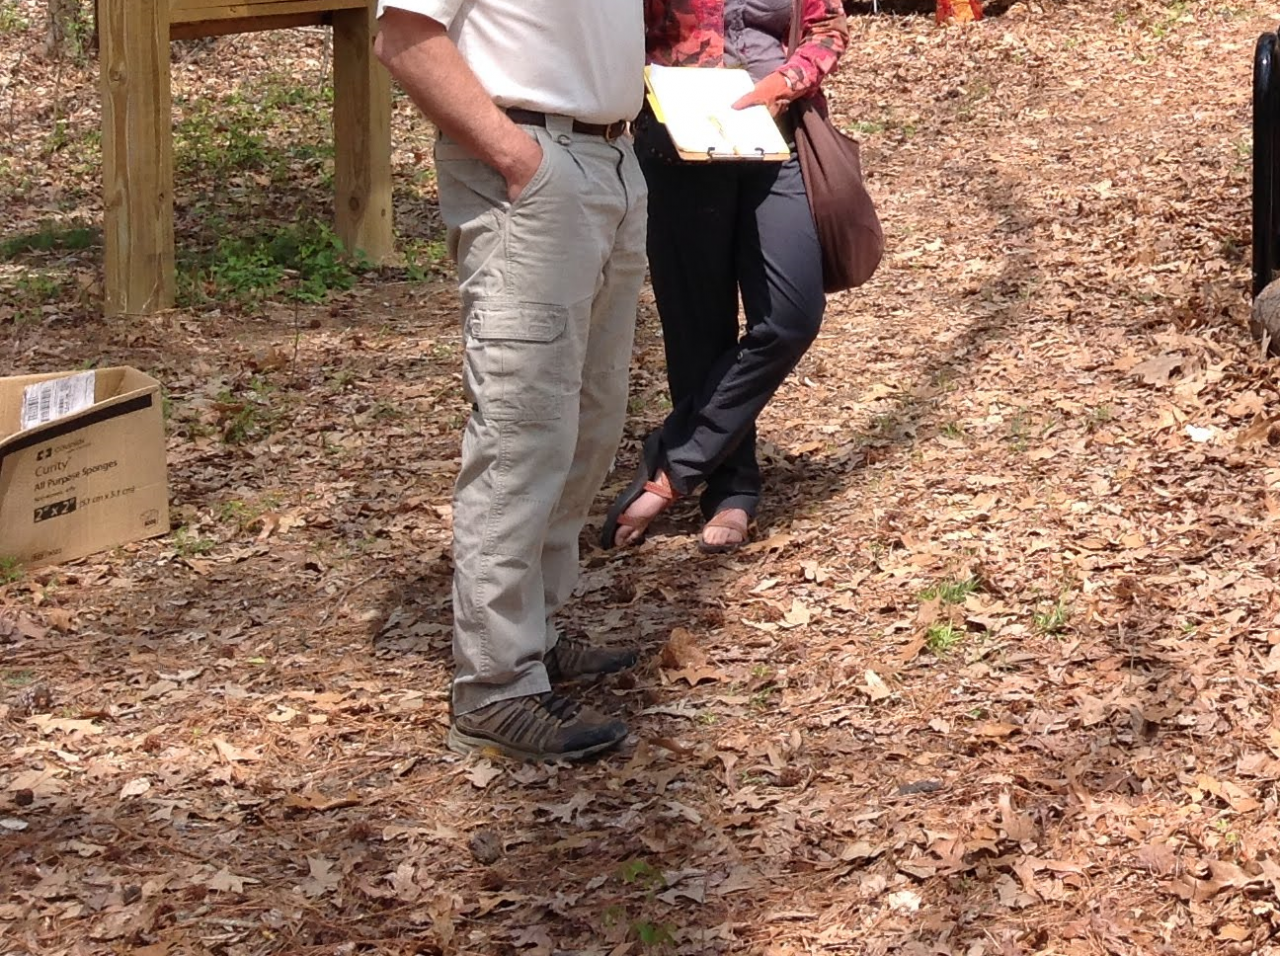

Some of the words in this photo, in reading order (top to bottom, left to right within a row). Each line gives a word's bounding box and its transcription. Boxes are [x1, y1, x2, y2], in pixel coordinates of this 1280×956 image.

[34, 481, 46, 492] All
[47, 471, 80, 488] Purpose
[82, 460, 118, 477] Sponges
[35, 459, 69, 477] Curity
[51, 507, 59, 516] x
[61, 498, 75, 514] 2"
